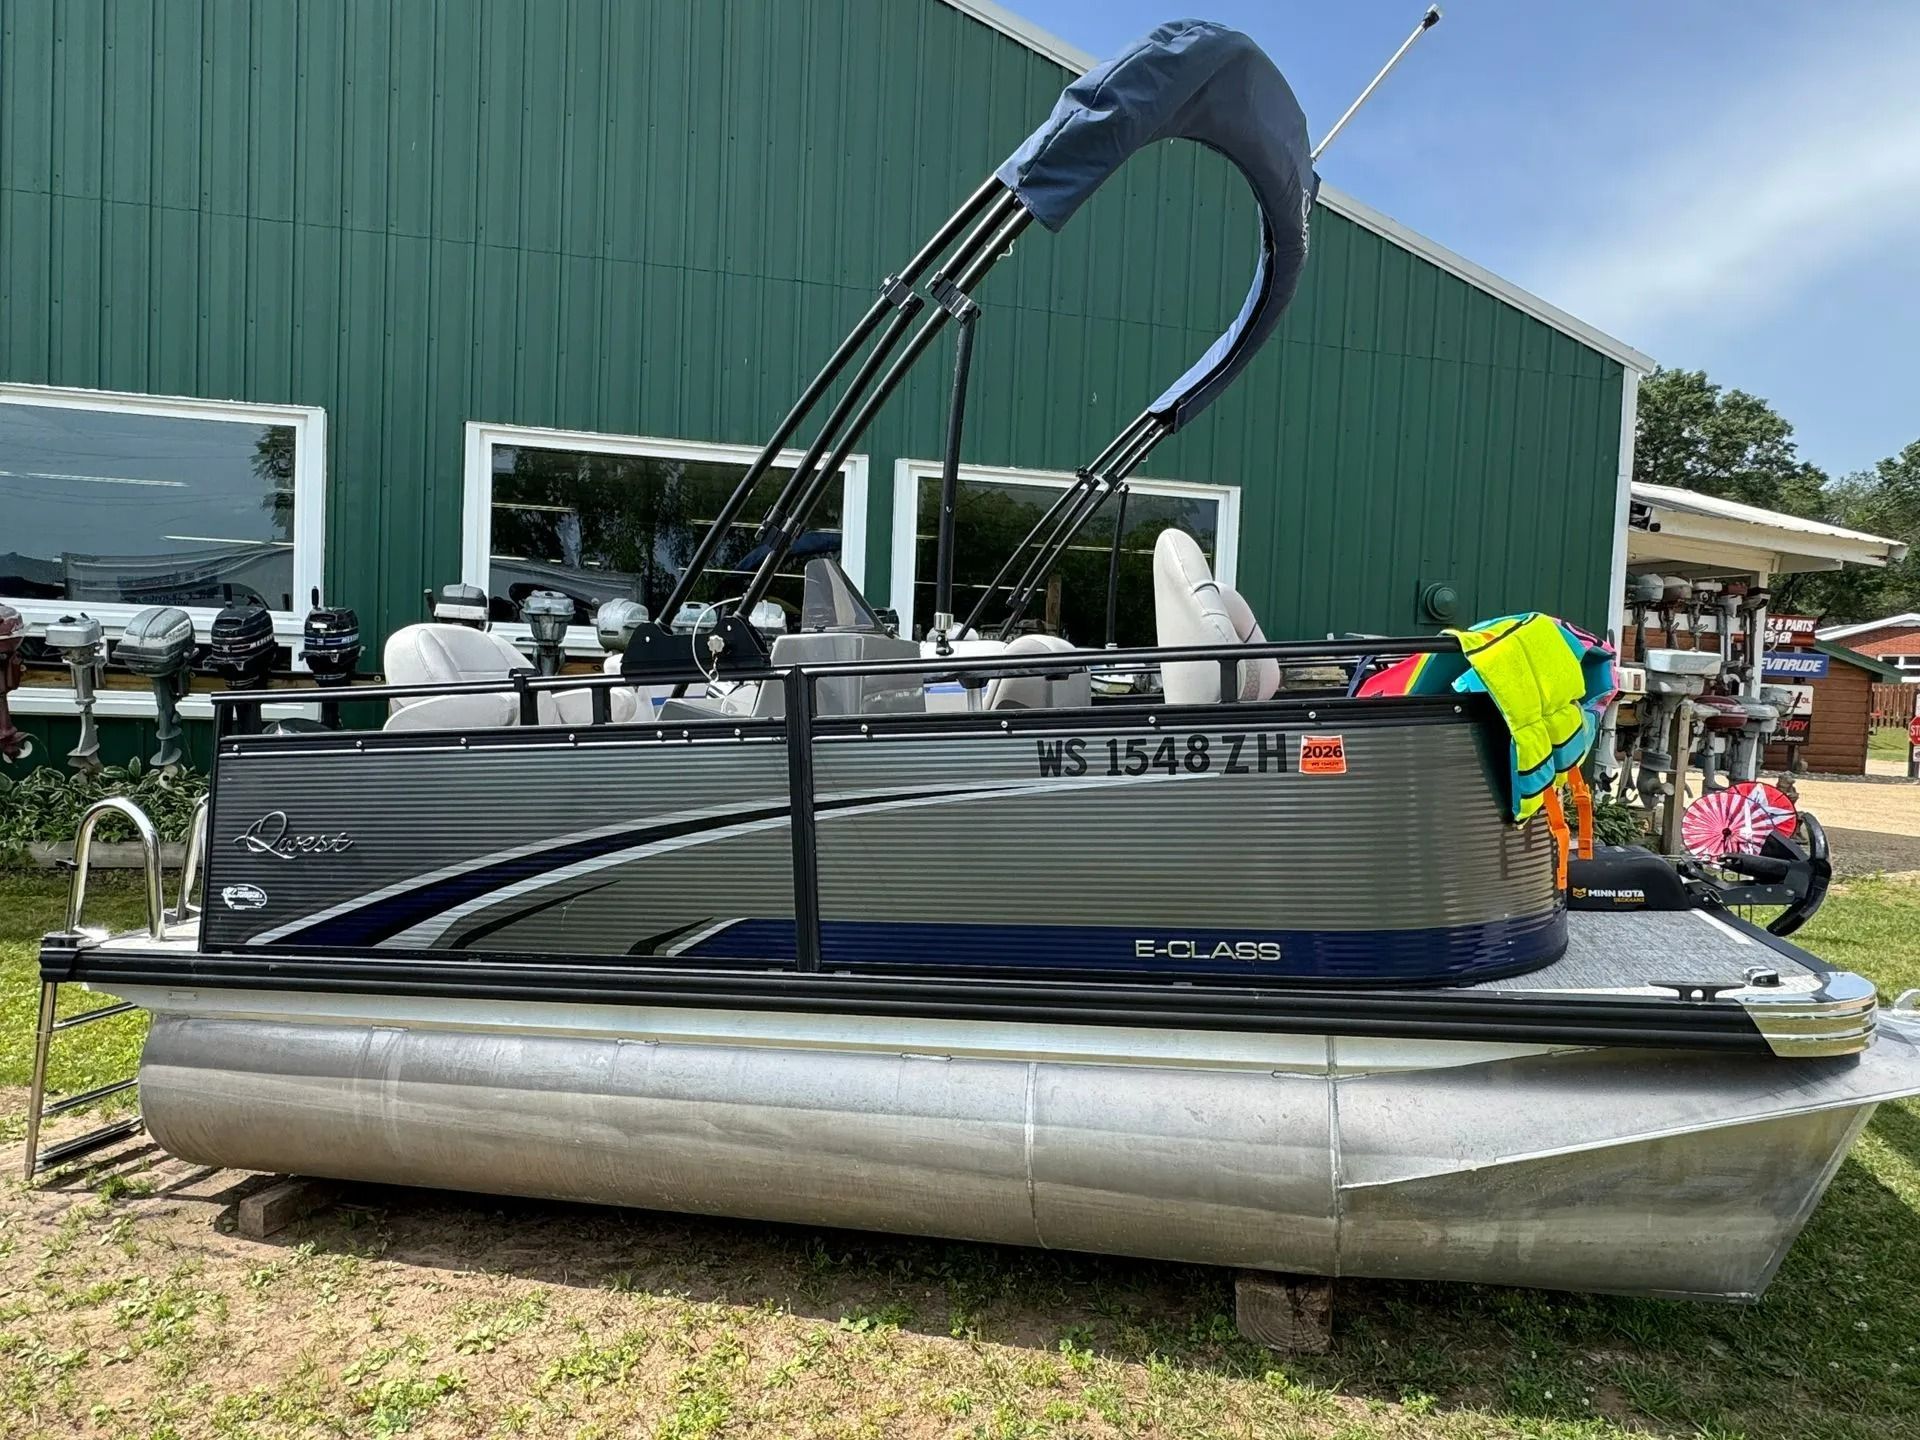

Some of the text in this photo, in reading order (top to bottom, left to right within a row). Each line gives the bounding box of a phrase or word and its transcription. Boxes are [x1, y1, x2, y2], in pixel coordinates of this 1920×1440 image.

[1784, 618, 1815, 632] PARTS
[1037, 738, 1088, 777] WS
[1106, 734, 1211, 776] 1548
[1302, 745, 1343, 758] 2026
[1588, 889, 1645, 898] MINN KOTA
[1135, 939, 1281, 961] E-CLASS
